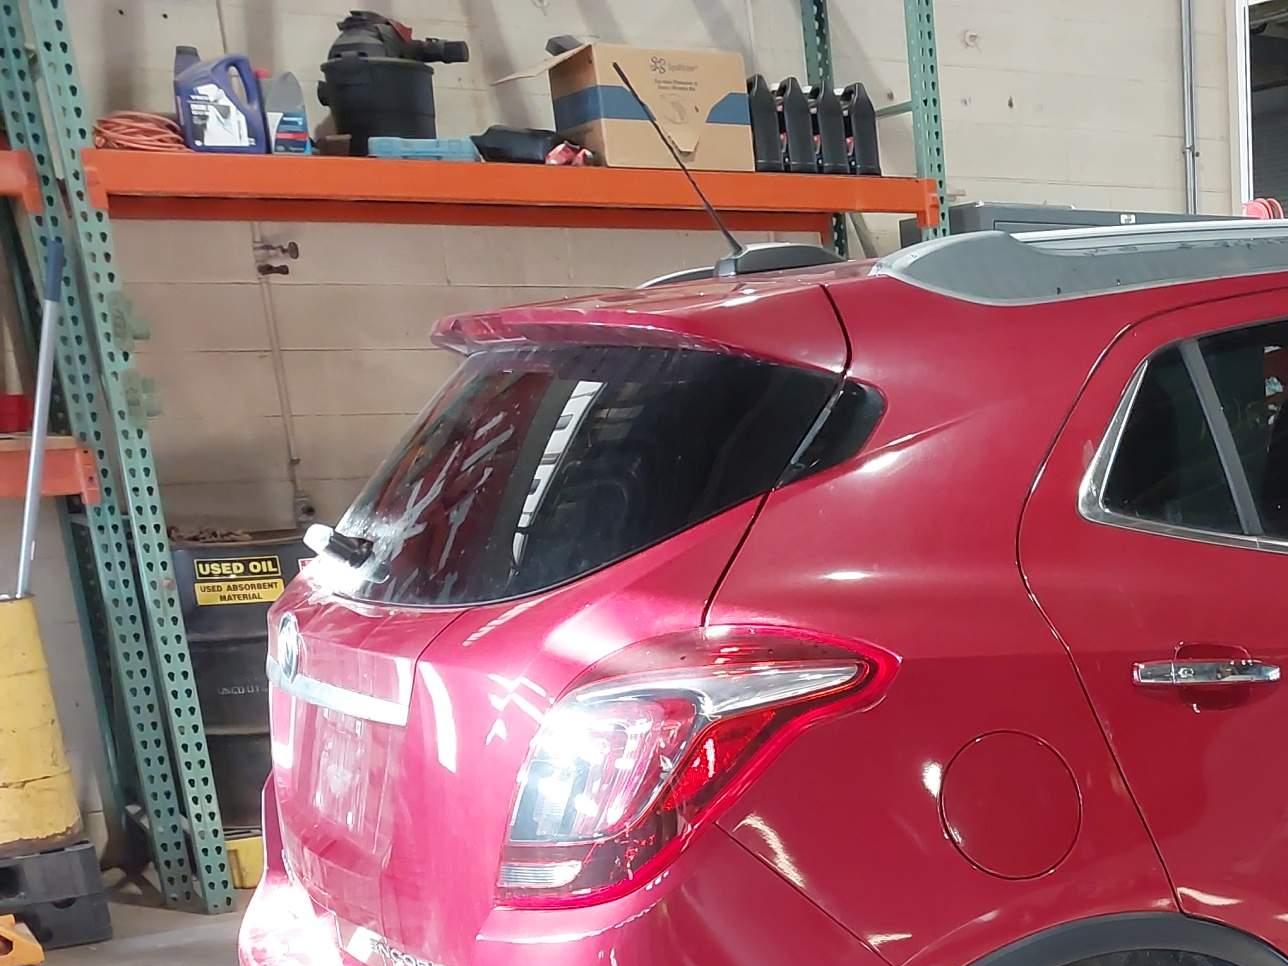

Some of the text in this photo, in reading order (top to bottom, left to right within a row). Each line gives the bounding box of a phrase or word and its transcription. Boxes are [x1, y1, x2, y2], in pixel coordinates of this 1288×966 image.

[199, 560, 278, 575] USED OIL
[200, 581, 279, 593] USED ABSORBENT
[219, 593, 263, 602] MATERIAL
